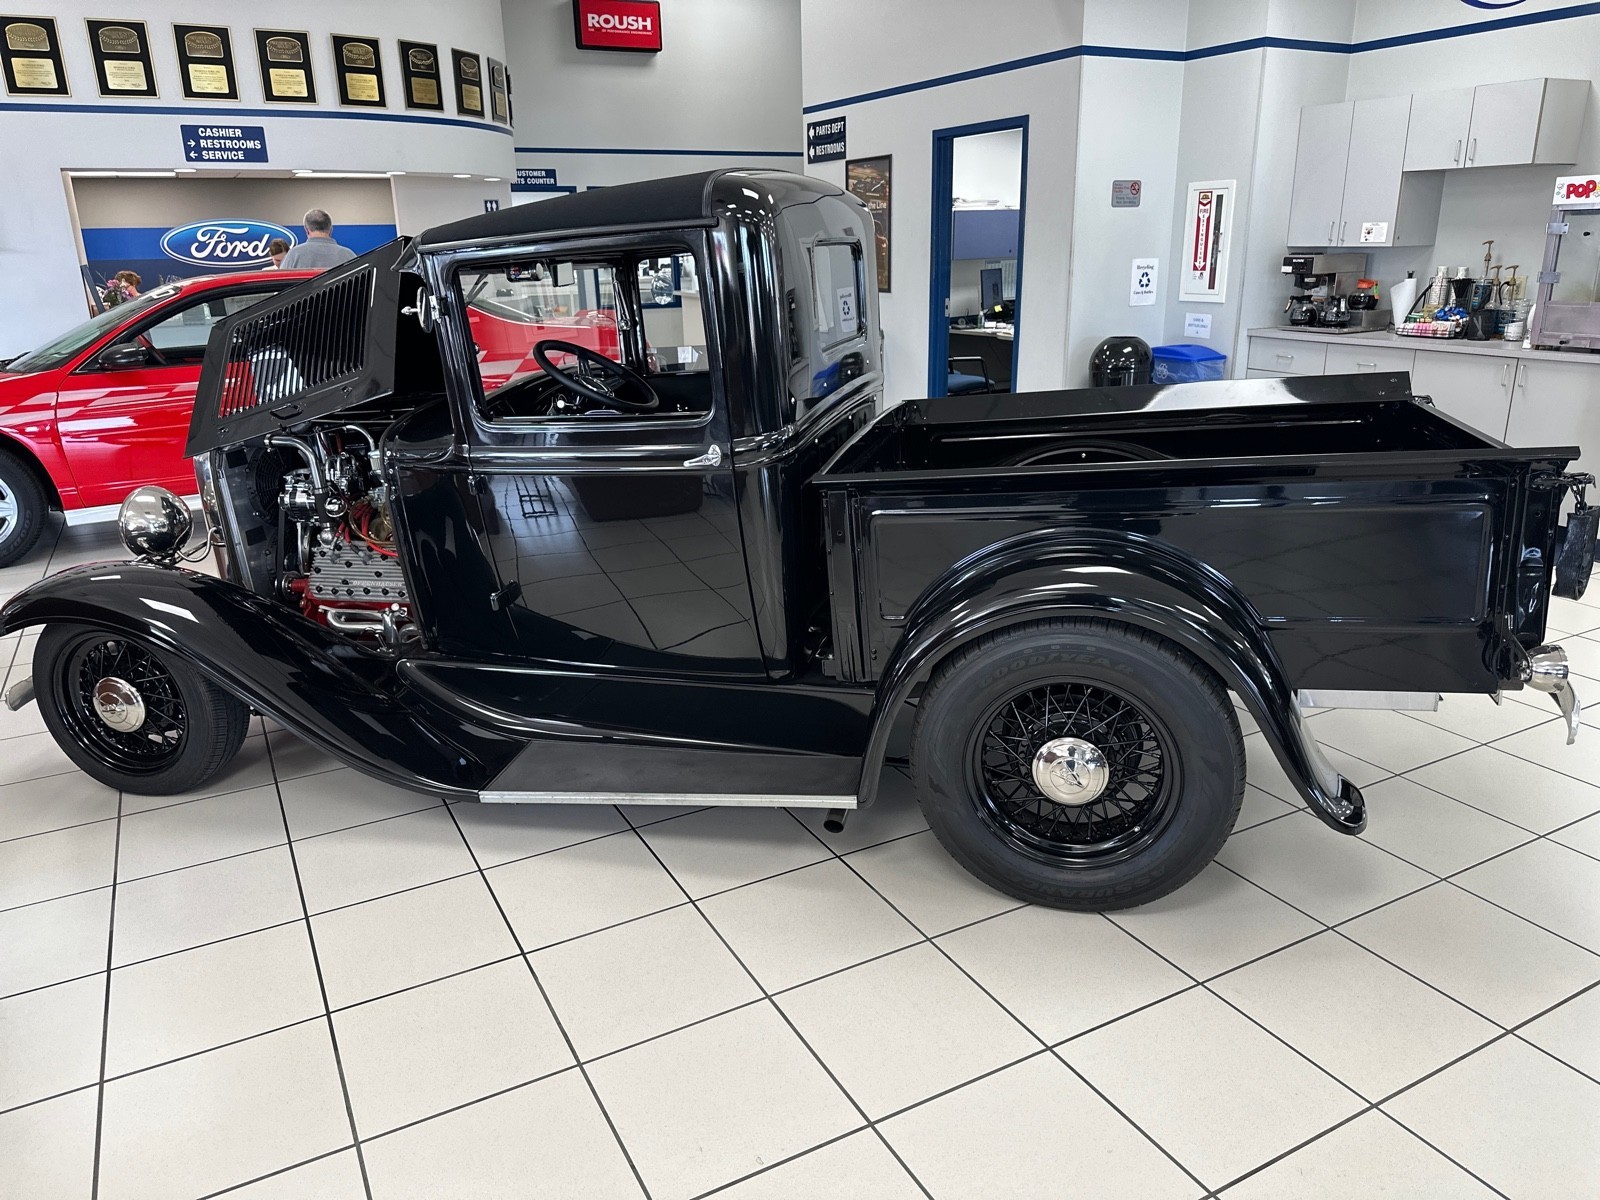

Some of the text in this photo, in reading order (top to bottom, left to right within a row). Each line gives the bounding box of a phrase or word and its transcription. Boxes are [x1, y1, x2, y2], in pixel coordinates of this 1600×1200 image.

[587, 13, 652, 30] ROUSH
[198, 127, 243, 138] CASHIER
[816, 122, 844, 136] PARTS DEPT
[200, 139, 262, 149] RESTROOMS
[816, 142, 844, 155] RESTROOMS
[202, 150, 245, 160] SERVICE
[527, 177, 555, 185] COUNTER
[1566, 179, 1600, 199] POP
[190, 226, 270, 259] Ford
[979, 653, 1134, 688] GOODYEAR
